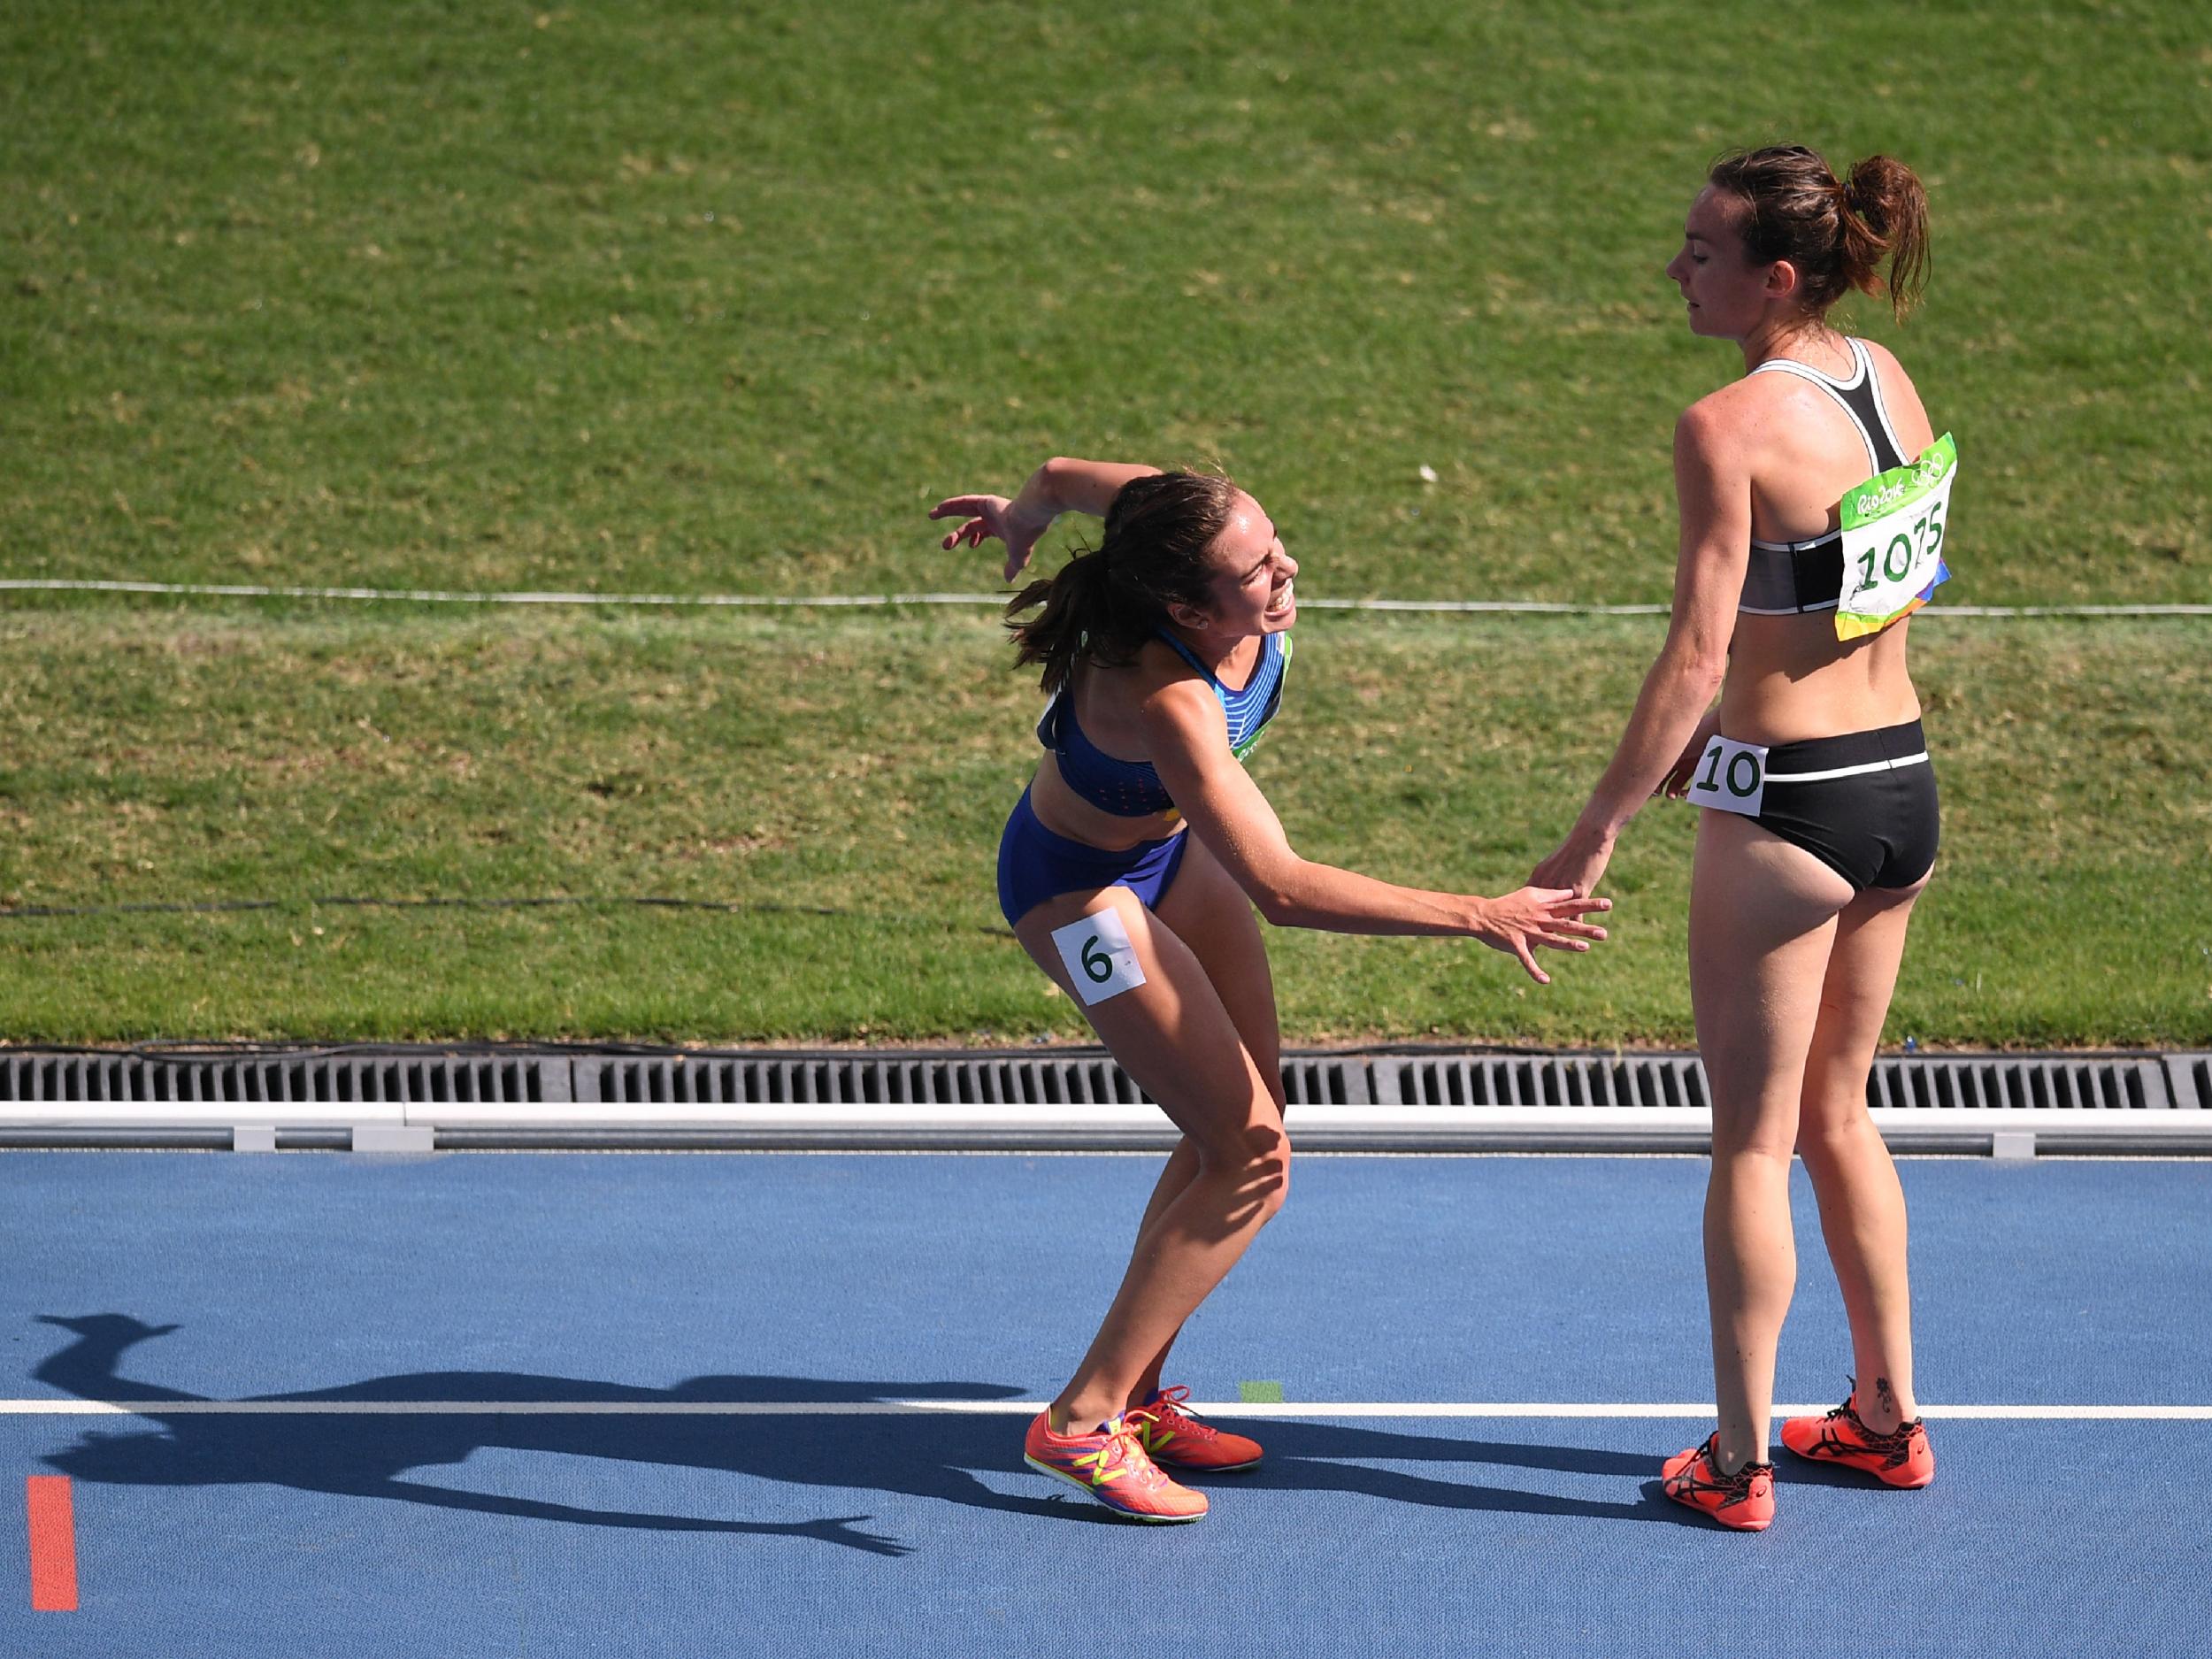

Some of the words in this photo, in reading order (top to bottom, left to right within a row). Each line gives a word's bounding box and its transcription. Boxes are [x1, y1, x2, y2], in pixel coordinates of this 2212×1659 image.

[1855, 501, 1943, 594] 1075
[1696, 745, 1761, 798] 10
[1081, 934, 1113, 984] 6
